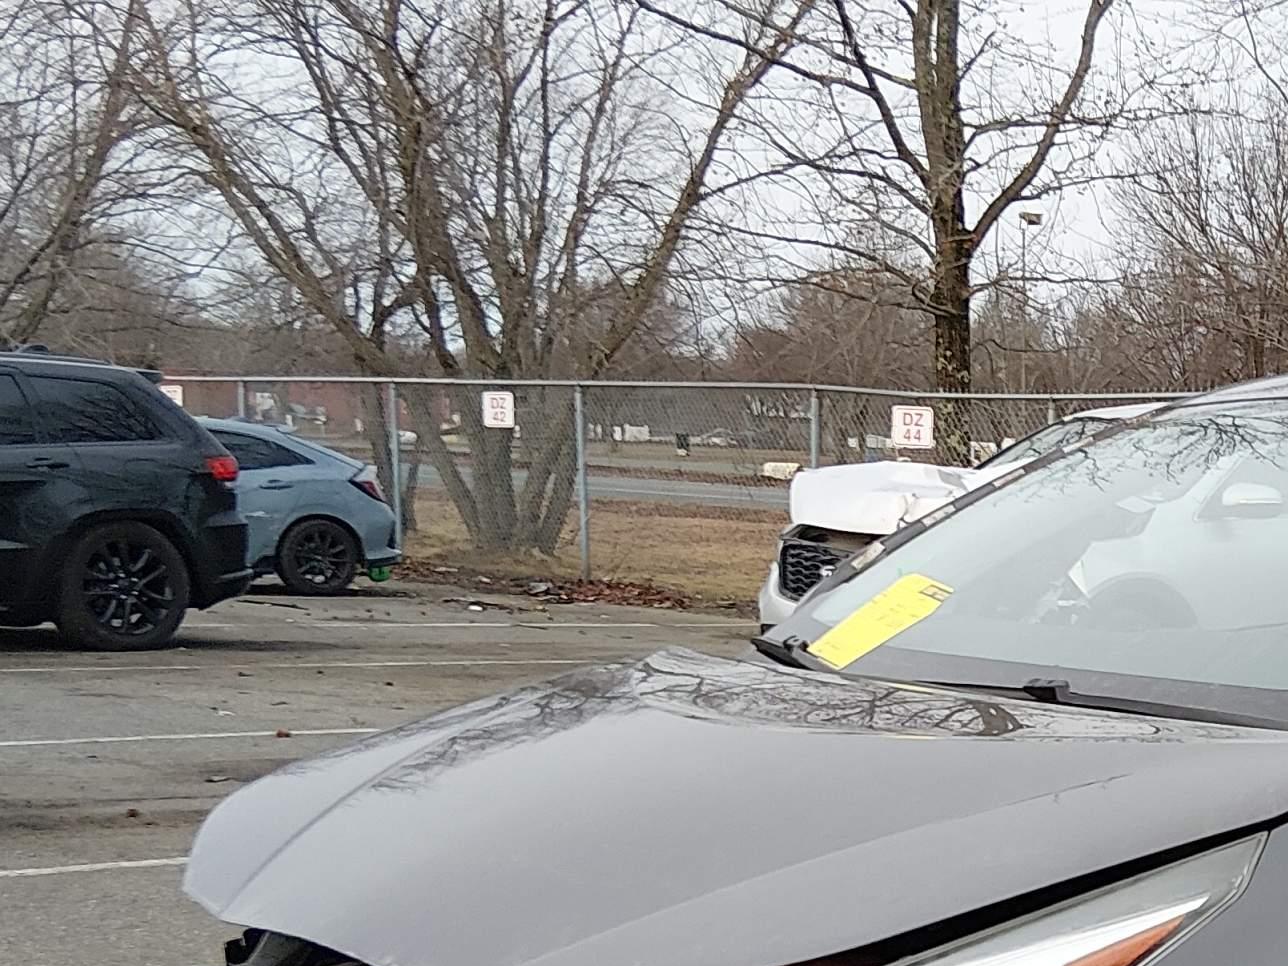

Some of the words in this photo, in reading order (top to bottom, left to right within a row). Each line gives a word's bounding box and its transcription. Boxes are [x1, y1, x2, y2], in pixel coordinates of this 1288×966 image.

[490, 397, 506, 409] DZ
[493, 411, 506, 422] 42
[903, 412, 924, 427] DZ
[903, 428, 922, 442] 44
